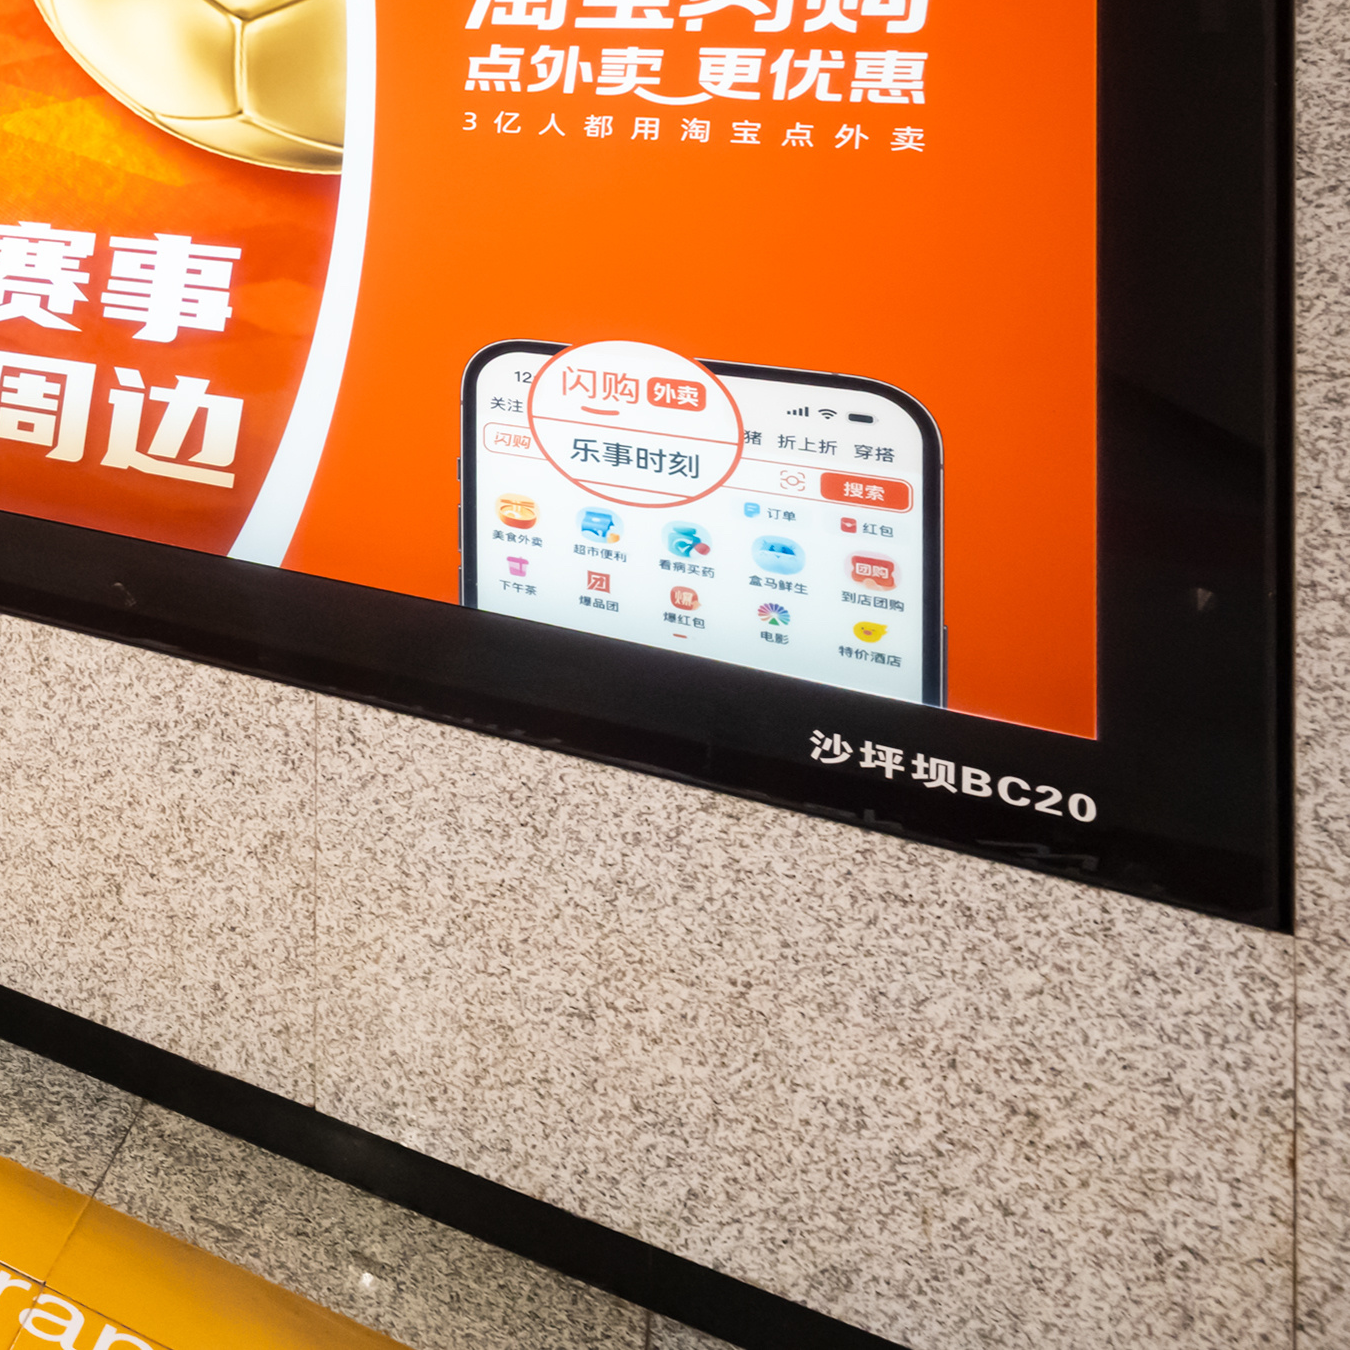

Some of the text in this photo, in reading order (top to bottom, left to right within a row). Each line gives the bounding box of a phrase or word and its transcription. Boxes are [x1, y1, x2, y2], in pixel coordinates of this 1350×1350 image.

[562, 366, 699, 407] 闪购 外卖
[490, 396, 524, 414] 关注
[494, 432, 531, 450] 闪购
[778, 434, 838, 455] 折上折
[854, 444, 895, 463] 穿搭
[570, 438, 700, 479] 乐事时刻
[844, 482, 885, 501] 搜索
[767, 508, 796, 521] 订单
[862, 522, 894, 537] 红包
[492, 530, 543, 548] 美食外卖
[573, 544, 627, 563] 超市便利
[659, 559, 715, 578] 看病买药
[856, 563, 889, 579] 团购
[500, 579, 537, 596] 下午茶
[748, 575, 808, 595] 盒马鲜生
[579, 595, 620, 613] 爆品团
[841, 590, 905, 612] 到店团购
[663, 612, 706, 629] 爆红包
[760, 631, 790, 645] 电影
[838, 645, 902, 668] 特价酒店
[809, 729, 1097, 823] 沙坪坝BC20
